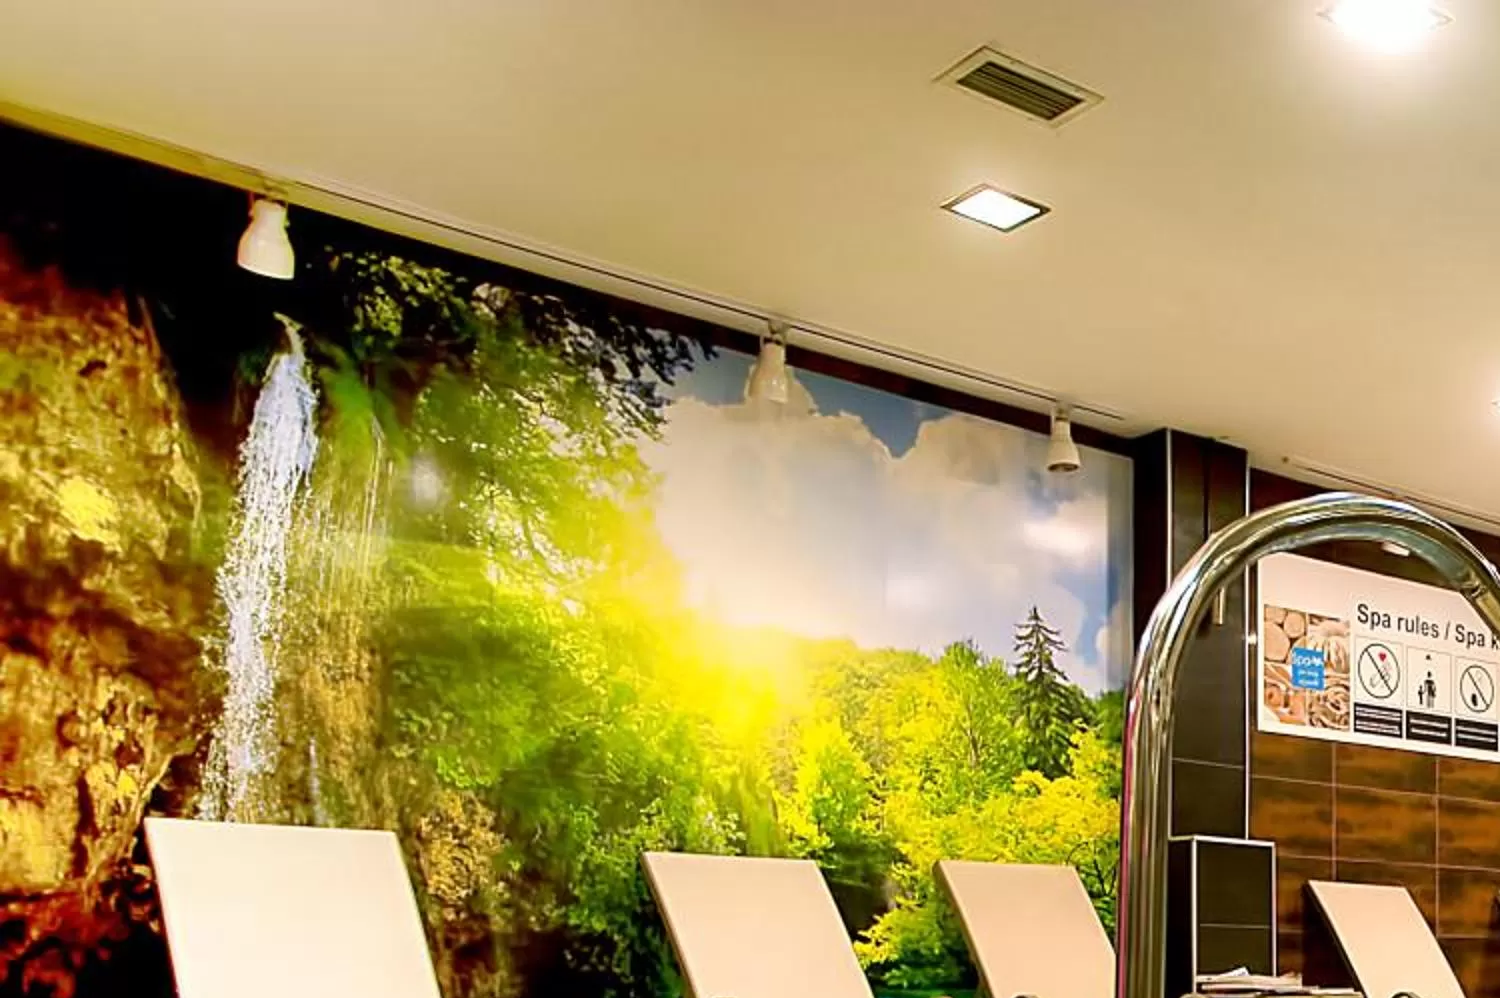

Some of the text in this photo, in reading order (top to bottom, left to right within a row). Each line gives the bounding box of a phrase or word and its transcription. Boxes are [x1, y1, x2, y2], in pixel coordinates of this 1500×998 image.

[1357, 603, 1391, 630] Spa
[1397, 615, 1439, 639] rules
[1443, 620, 1451, 641] /
[1455, 624, 1486, 649] Spa
